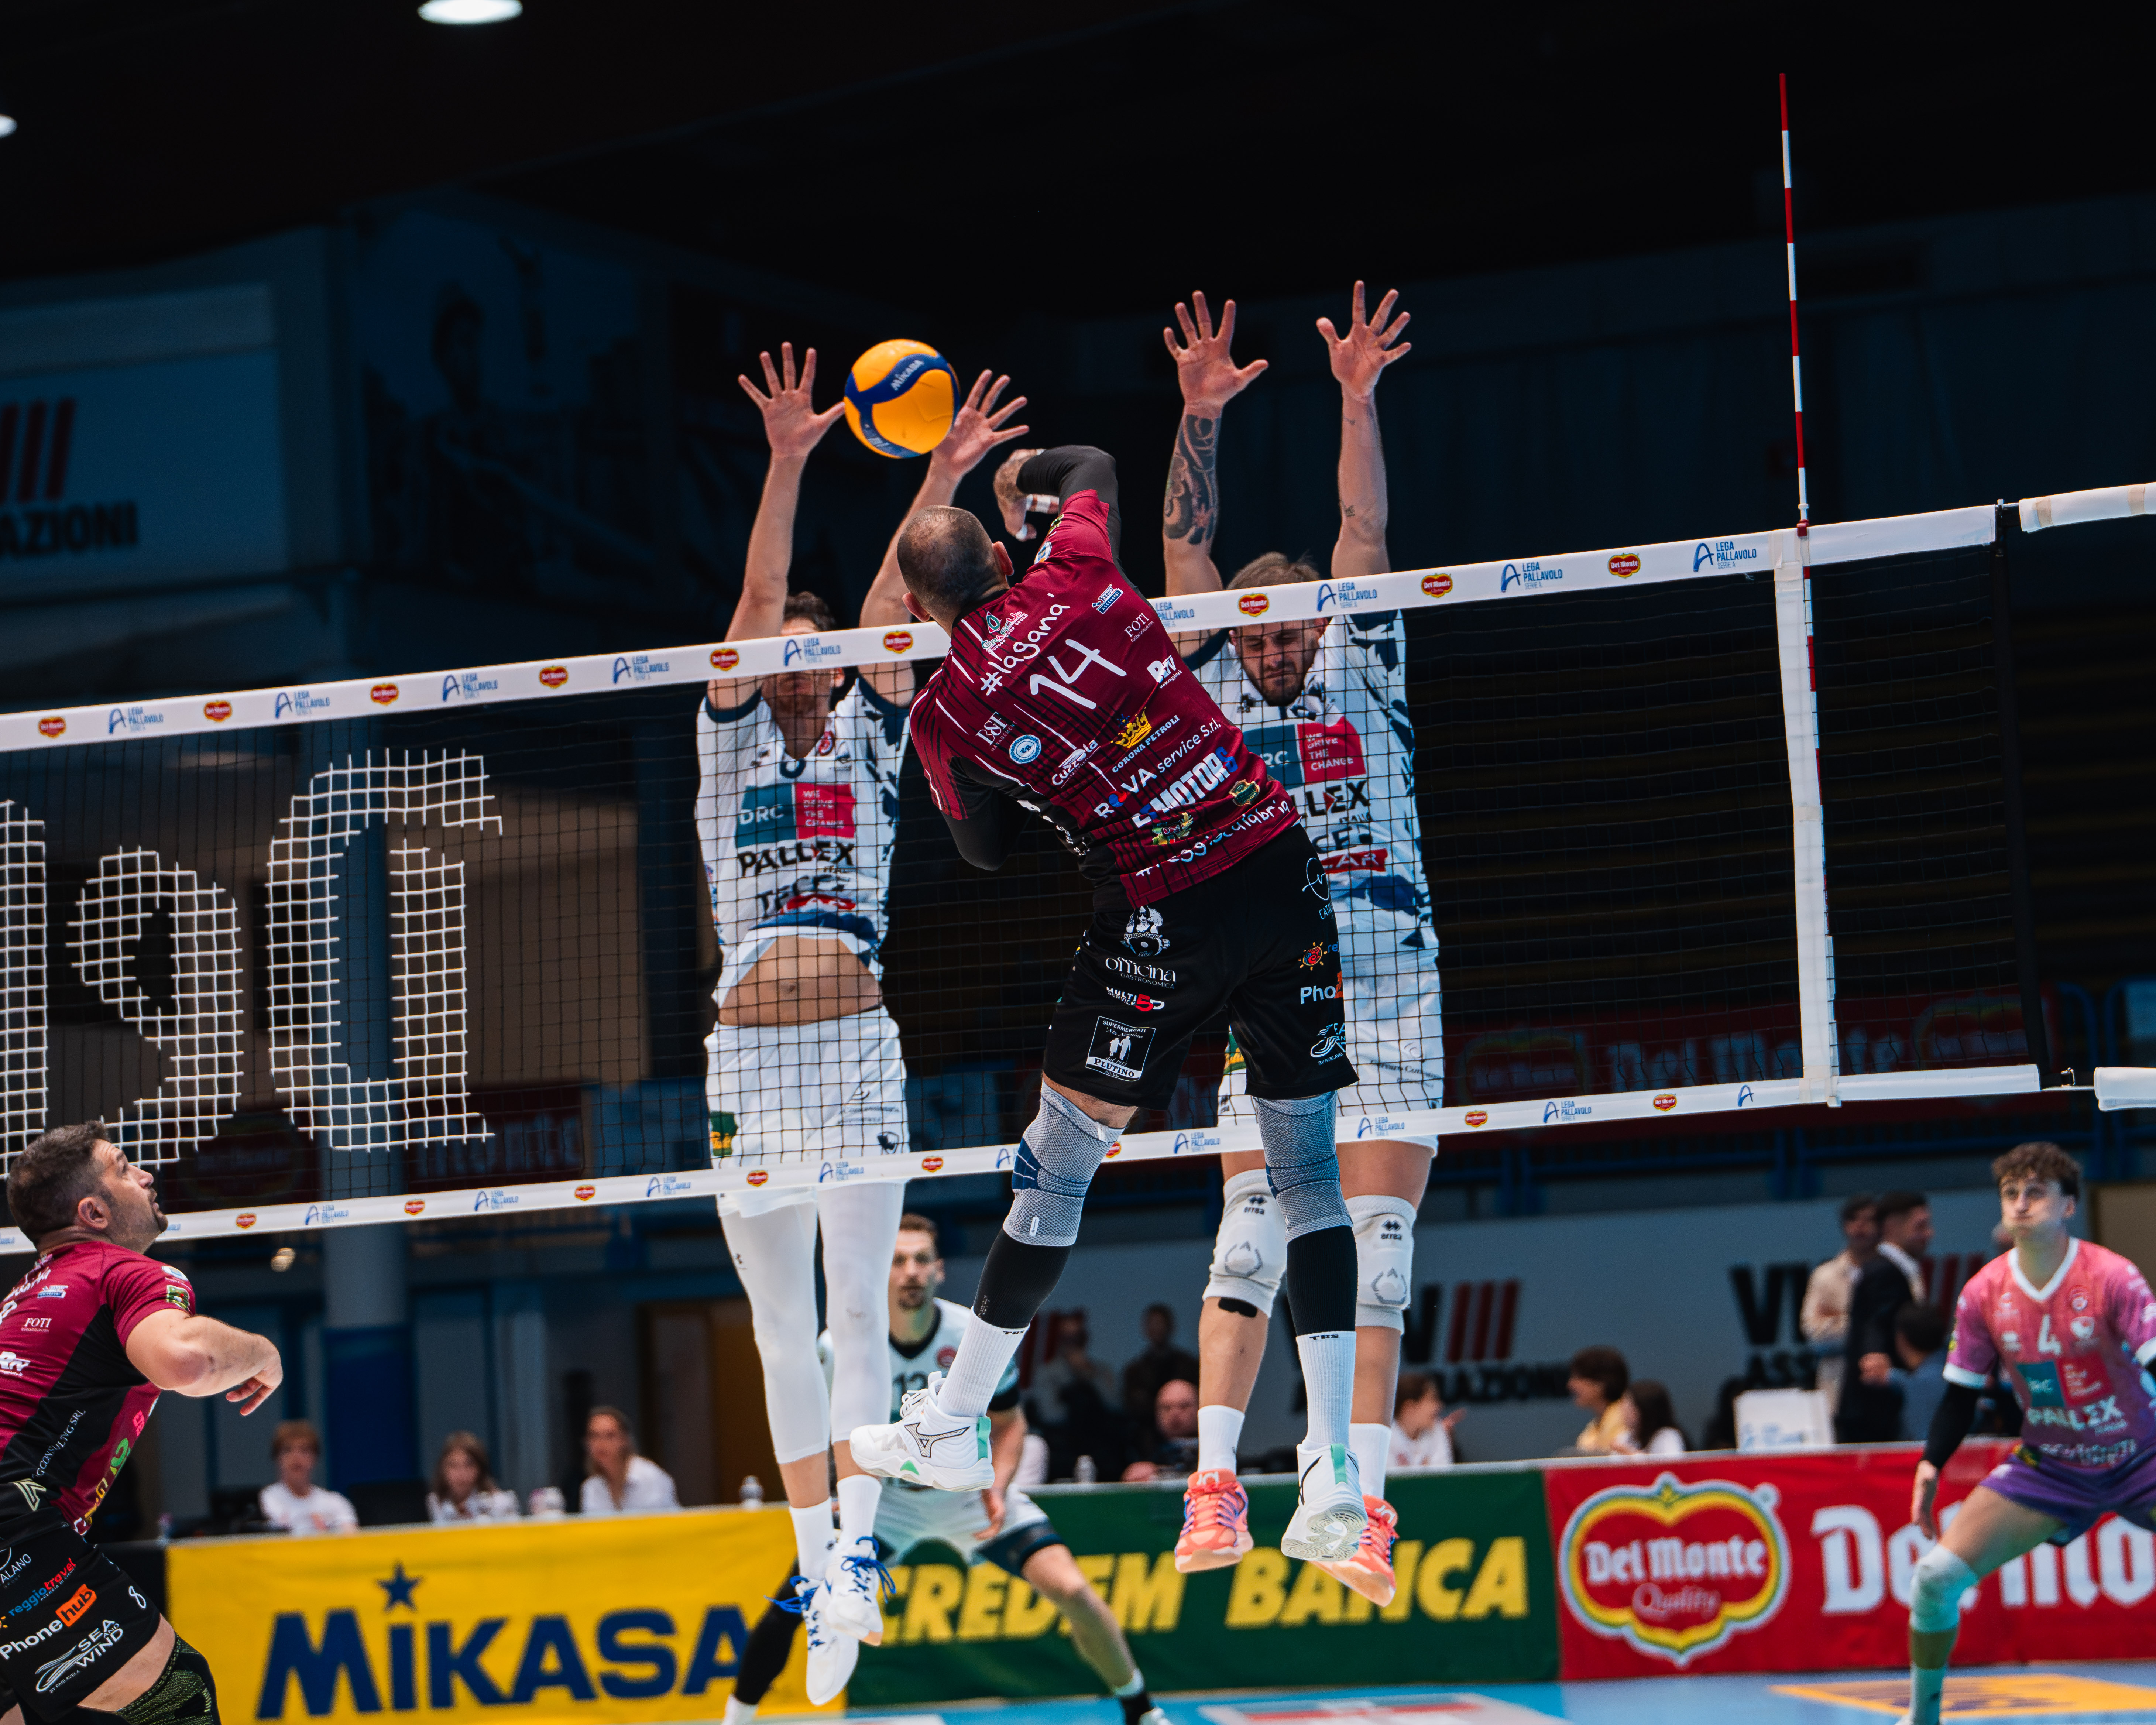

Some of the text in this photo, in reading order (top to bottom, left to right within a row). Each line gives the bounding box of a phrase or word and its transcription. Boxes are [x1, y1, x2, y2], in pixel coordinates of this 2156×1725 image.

[1716, 542, 1734, 552] LEGA
[1716, 549, 1757, 562] PALLAVOLO
[1523, 562, 1540, 572] LEGA
[1524, 569, 1563, 581] PALLAVOLO
[1338, 582, 1355, 591] LEGA
[1339, 589, 1377, 601] PALLAVOLO
[1102, 591, 1120, 610] ASCENSORI
[1155, 601, 1173, 611] LEGA
[1124, 613, 1149, 637] FOTI
[1029, 639, 1127, 709] 14
[991, 720, 1017, 752] MANAGEMENT
[1112, 715, 1180, 773] CORONA PETROLI
[1157, 734, 1201, 773] service
[1200, 717, 1221, 737] S.r.l.
[1308, 749, 1329, 759] THE
[1311, 757, 1354, 771] CHANGE
[739, 804, 784, 825] DRC
[738, 841, 855, 877] PALLEX
[1120, 973, 1174, 990] GASTRONOMICA
[1106, 987, 1137, 1002] MULTI
[1108, 991, 1136, 1006] SERVICE
[1102, 1020, 1146, 1033] SUPERMERCATI
[1094, 1058, 1135, 1077] PLUTINO
[24, 1318, 52, 1328] FOTI
[2037, 1314, 2063, 1357] 4
[70, 1410, 86, 1425] SRL
[1584, 1534, 1767, 1585] Del Monte
[128, 1585, 147, 1609] 8
[1632, 1583, 1720, 1620] Quality
[78, 1619, 116, 1652] SEA
[76, 1628, 123, 1668] WIND
[255, 1604, 752, 1720] MIKASA
